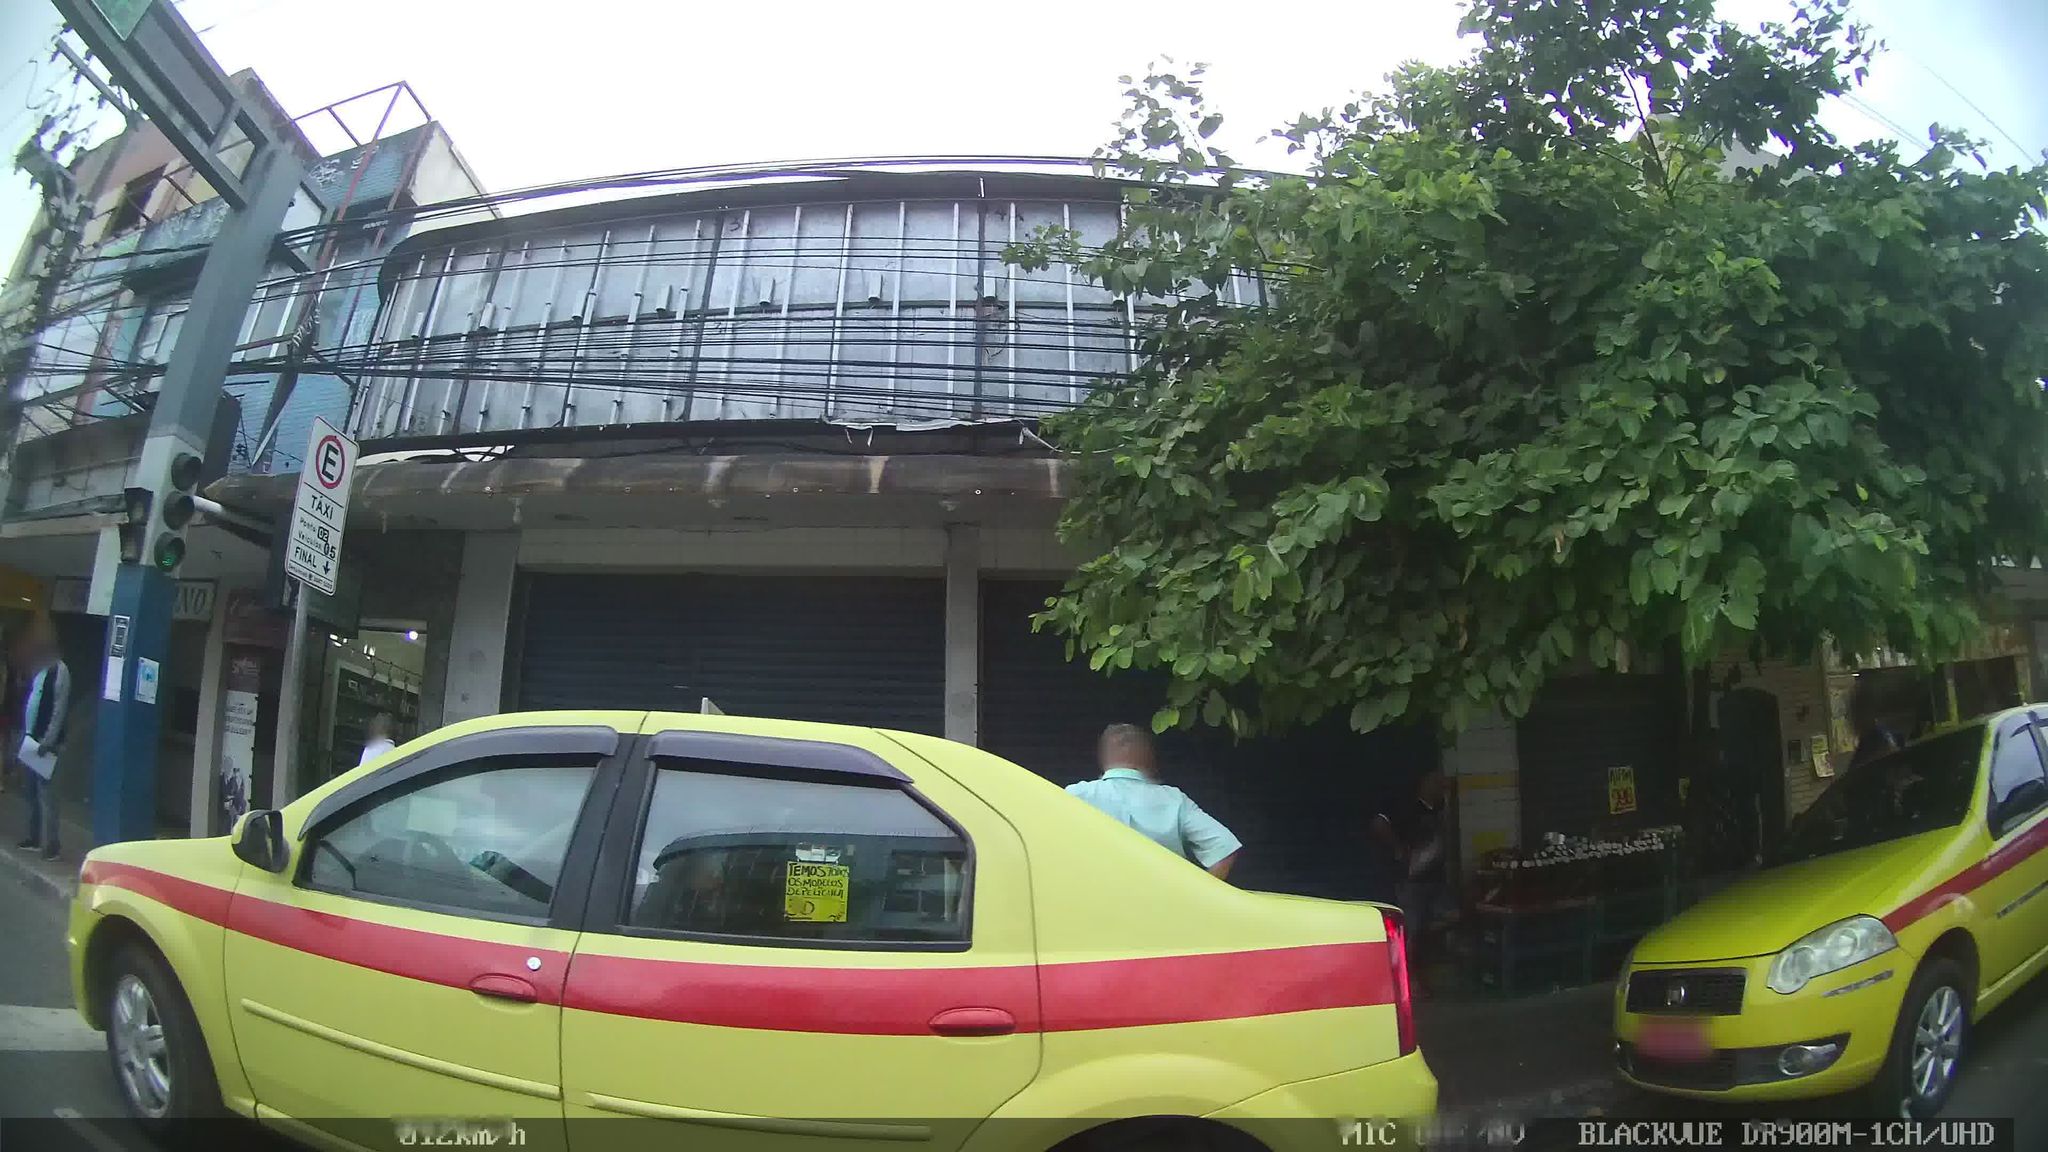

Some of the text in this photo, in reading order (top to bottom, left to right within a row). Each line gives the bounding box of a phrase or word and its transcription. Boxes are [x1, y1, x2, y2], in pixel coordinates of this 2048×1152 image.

[321, 442, 339, 482] E
[295, 546, 317, 568] FINAL
[323, 542, 337, 559] 05
[788, 863, 826, 877] TEMOS
